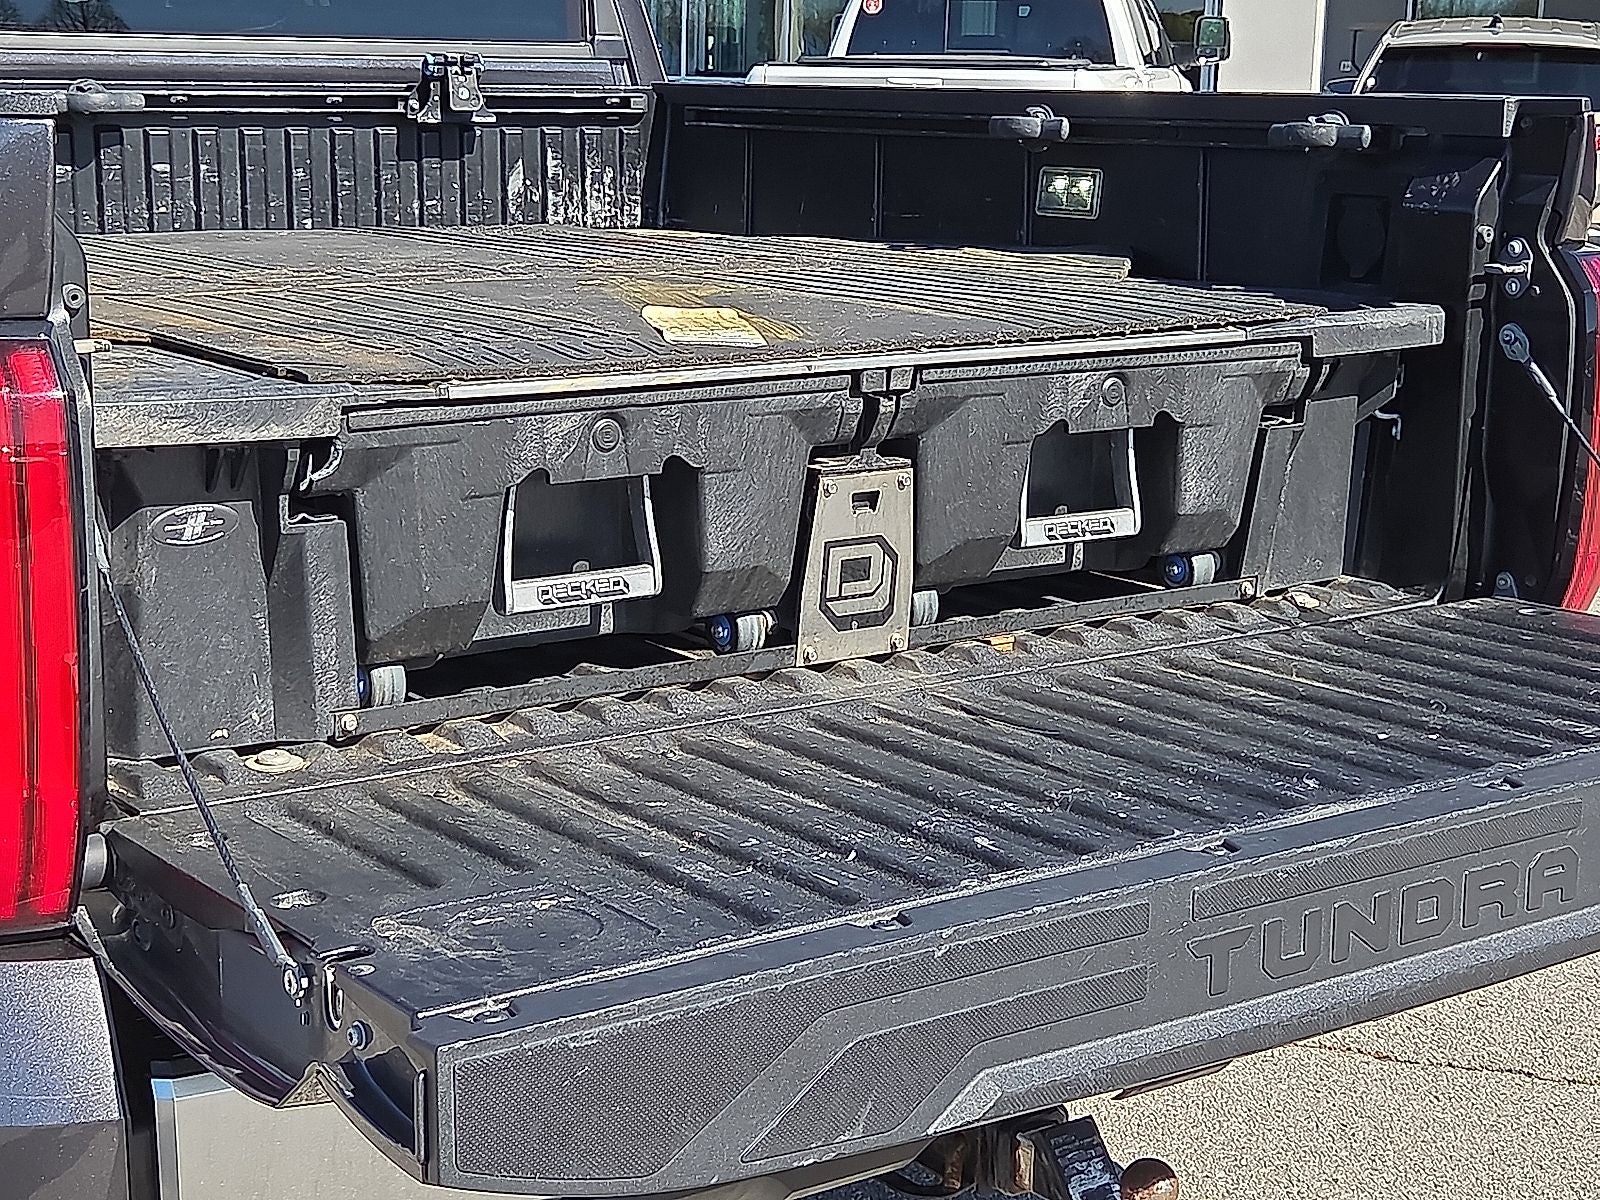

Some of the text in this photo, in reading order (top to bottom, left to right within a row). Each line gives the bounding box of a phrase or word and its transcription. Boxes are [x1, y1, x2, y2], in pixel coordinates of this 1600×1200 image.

[1043, 517, 1116, 541] DECKED
[536, 576, 631, 605] DECKED
[1186, 846, 1580, 998] TUNDRA
